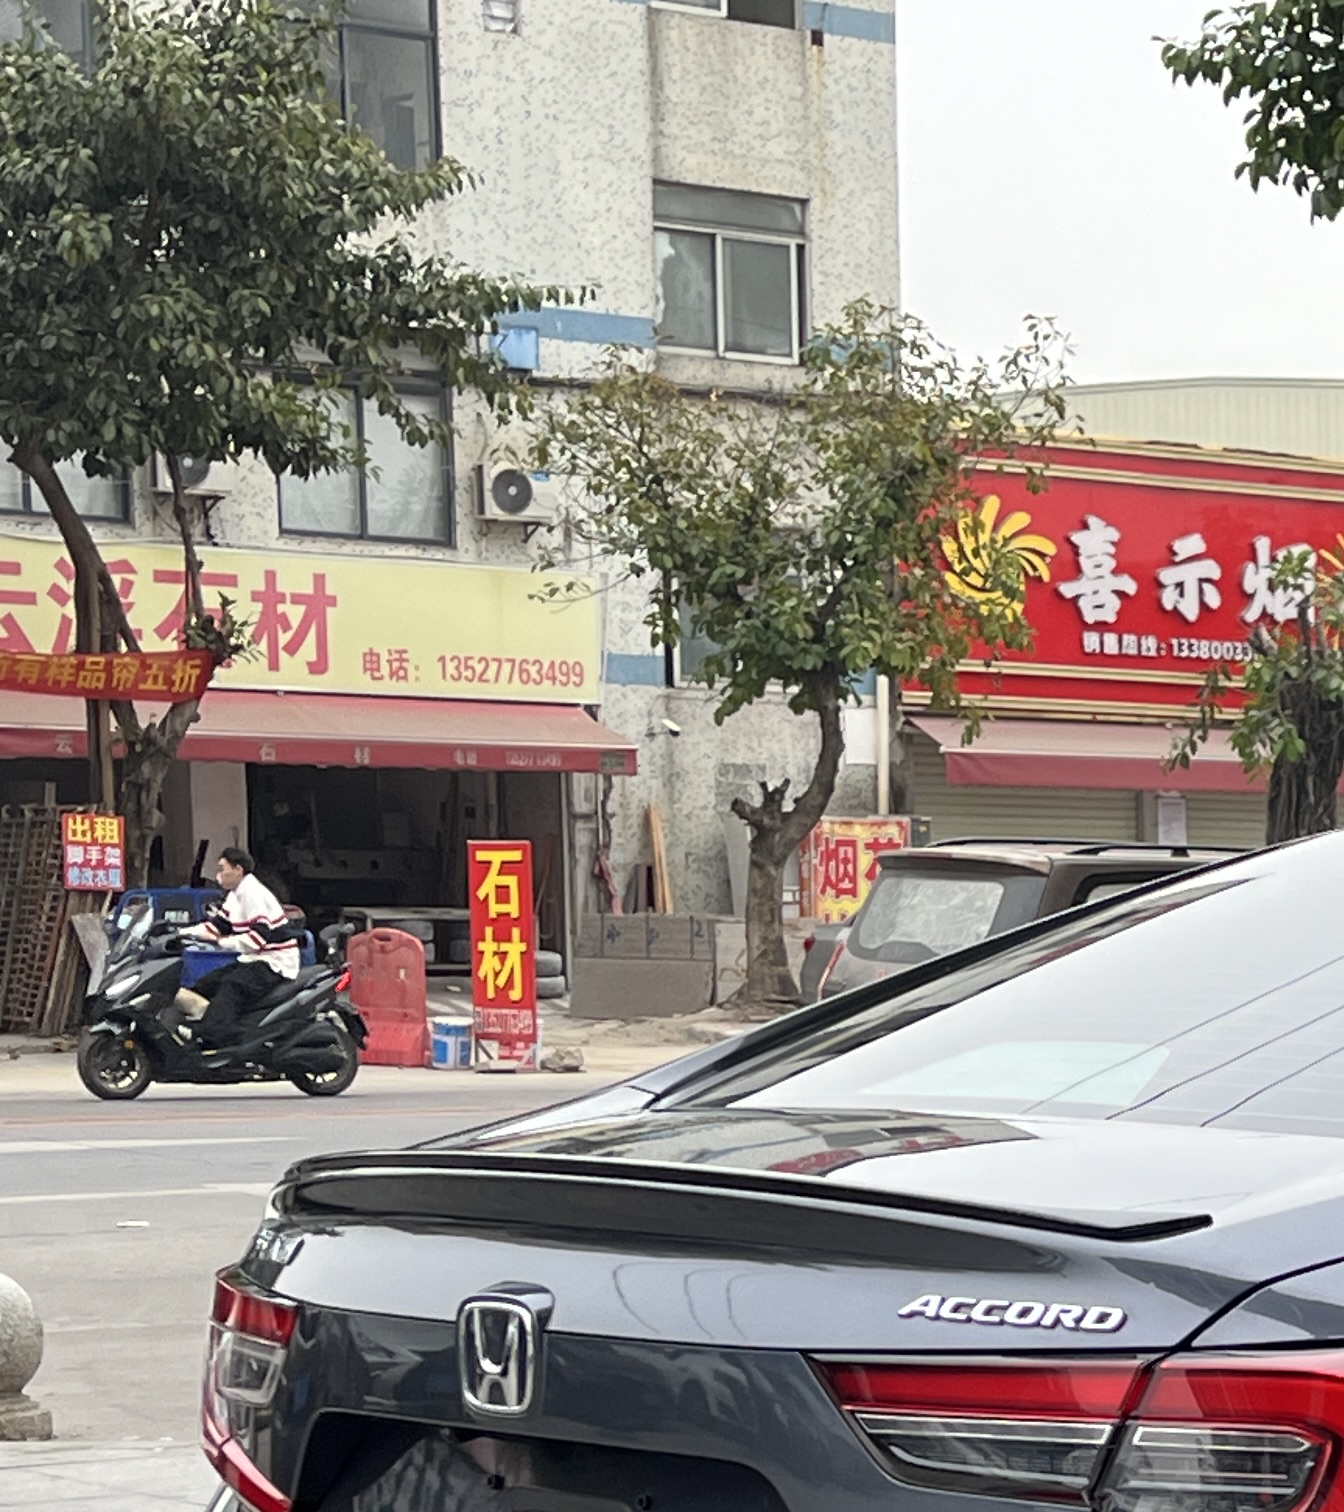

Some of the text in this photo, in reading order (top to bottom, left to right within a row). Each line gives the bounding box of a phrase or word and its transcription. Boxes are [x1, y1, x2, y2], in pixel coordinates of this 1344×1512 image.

[437, 655, 585, 687] 13527763499
[67, 815, 119, 844] 出租
[475, 850, 527, 1001] 石材
[898, 1294, 1127, 1332] ACCORD
